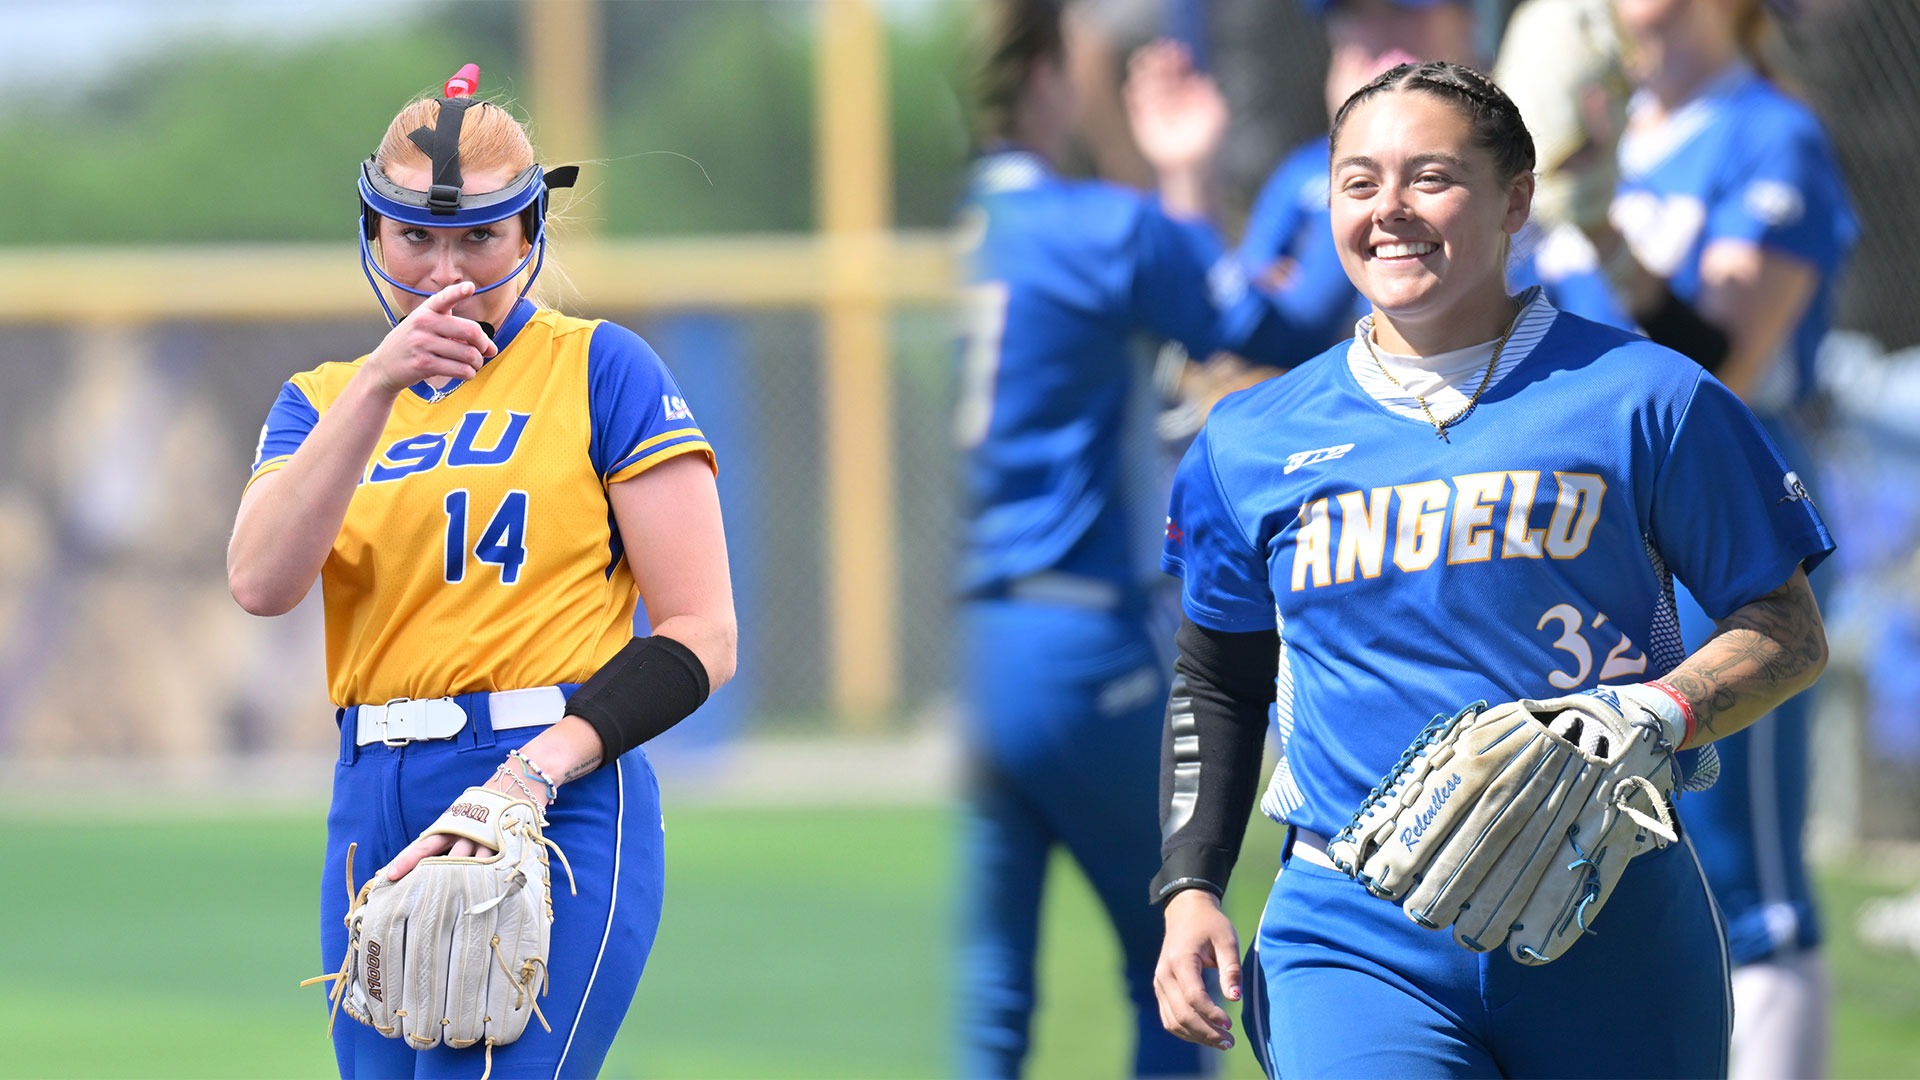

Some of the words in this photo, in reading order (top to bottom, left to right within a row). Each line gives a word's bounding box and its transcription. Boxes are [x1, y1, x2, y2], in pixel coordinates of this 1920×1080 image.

[357, 409, 532, 487] SU
[444, 488, 529, 586] 14
[1291, 470, 1607, 592] ANGELO
[1536, 603, 1647, 689] 32
[1400, 773, 1462, 853] Relentless
[366, 940, 383, 1003] A1000
